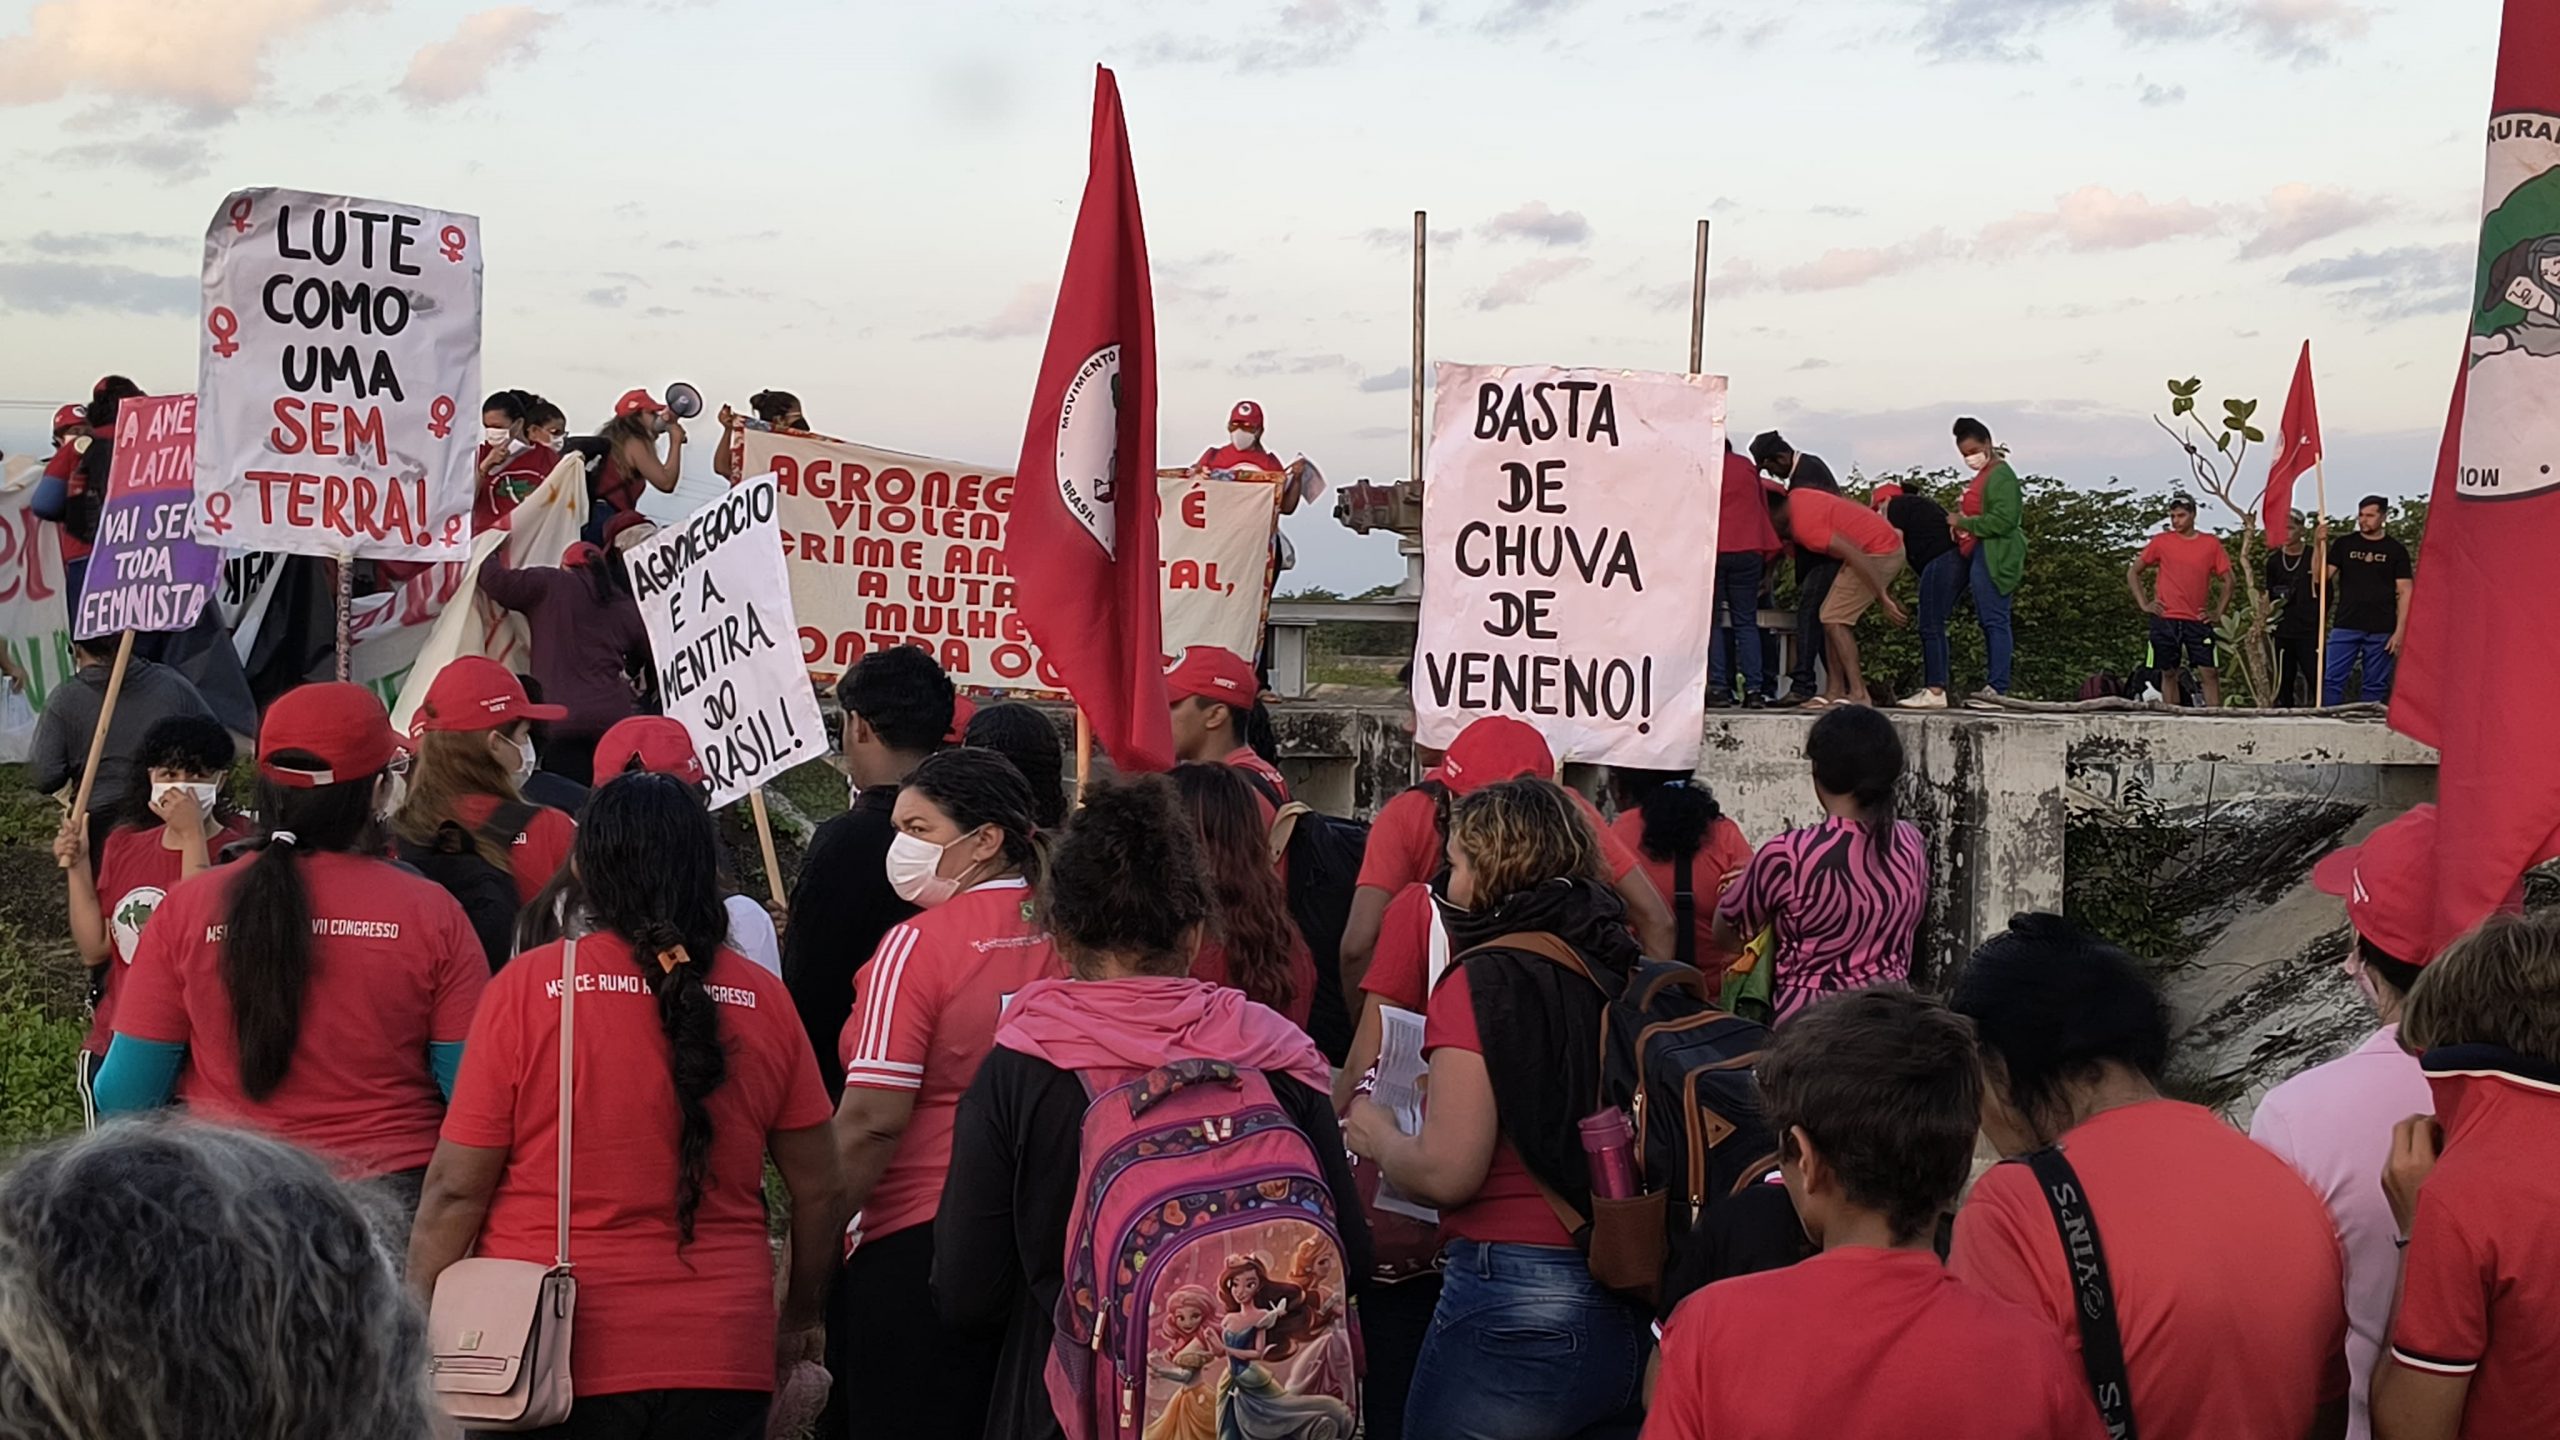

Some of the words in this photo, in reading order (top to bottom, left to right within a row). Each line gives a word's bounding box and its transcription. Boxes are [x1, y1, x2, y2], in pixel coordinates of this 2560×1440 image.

[277, 205, 421, 275] LUTE
[262, 274, 410, 336] COMO
[282, 345, 404, 402] UMA
[1061, 350, 1116, 429] MOVIMENTO
[121, 411, 139, 448] A
[271, 397, 388, 466] SEM
[1474, 382, 1619, 447] BASTA
[244, 471, 431, 547] TERRA!
[1062, 480, 1095, 526] BRASIL
[1181, 482, 1206, 529] É
[1498, 460, 1567, 514] DE
[105, 506, 140, 545] VAI
[147, 503, 197, 541] SER
[115, 546, 173, 582] TODA
[1455, 520, 1643, 592] CHUVA
[670, 575, 686, 633] É
[701, 569, 725, 613] A
[857, 570, 887, 598] A
[908, 575, 1019, 609] LUTA
[1483, 589, 1558, 639] DE
[662, 602, 775, 709] MENTIRA
[703, 680, 737, 730] DO
[1425, 652, 1652, 734] VENENO!
[312, 918, 328, 935] VII
[330, 919, 399, 938] CONGRESSO
[598, 974, 639, 993] RUMO
